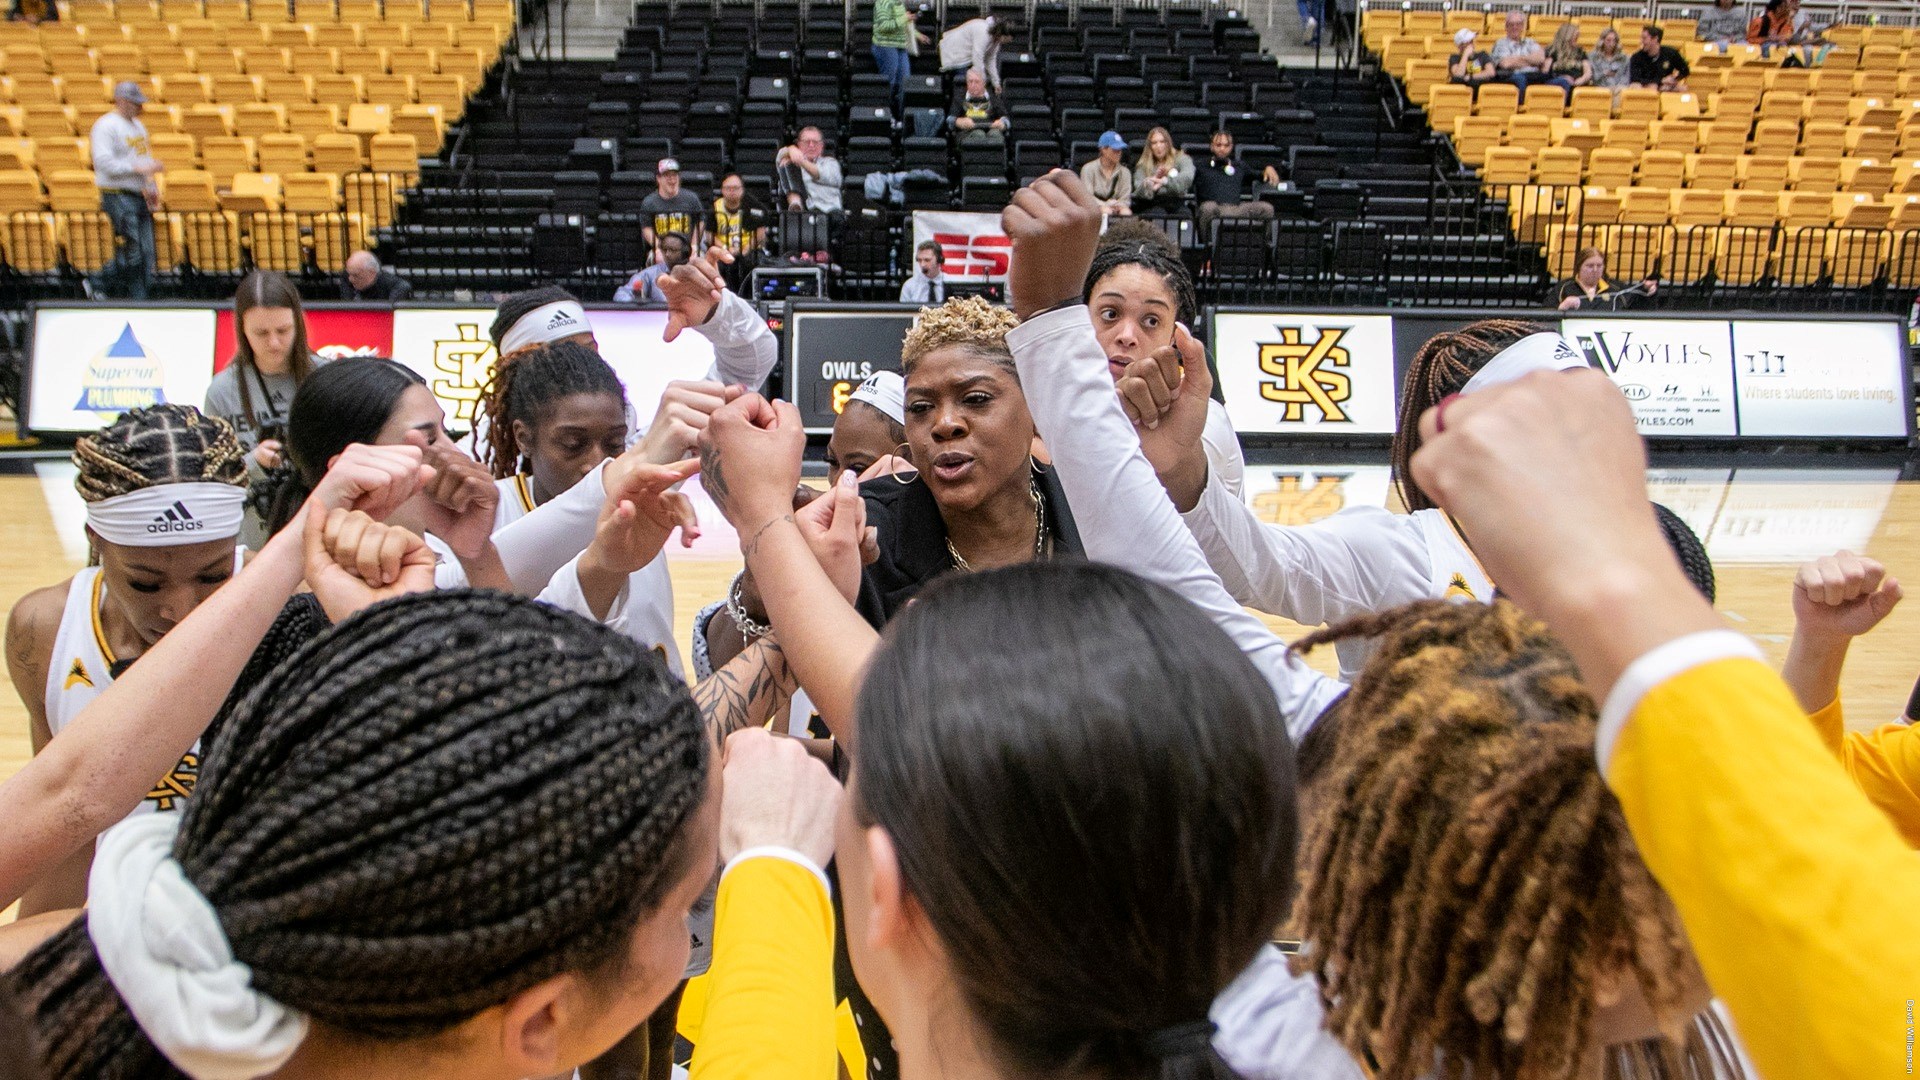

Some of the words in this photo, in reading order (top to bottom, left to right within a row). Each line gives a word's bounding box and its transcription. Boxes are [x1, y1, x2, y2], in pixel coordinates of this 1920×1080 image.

[547, 318, 577, 330] adidas
[1594, 331, 1713, 373] VOYLES
[822, 361, 872, 380] OWLS
[1623, 389, 1646, 397] KIA
[1744, 386, 1781, 399] Where
[1785, 386, 1834, 400] students
[1837, 386, 1860, 400] love
[147, 520, 203, 533] adidas
